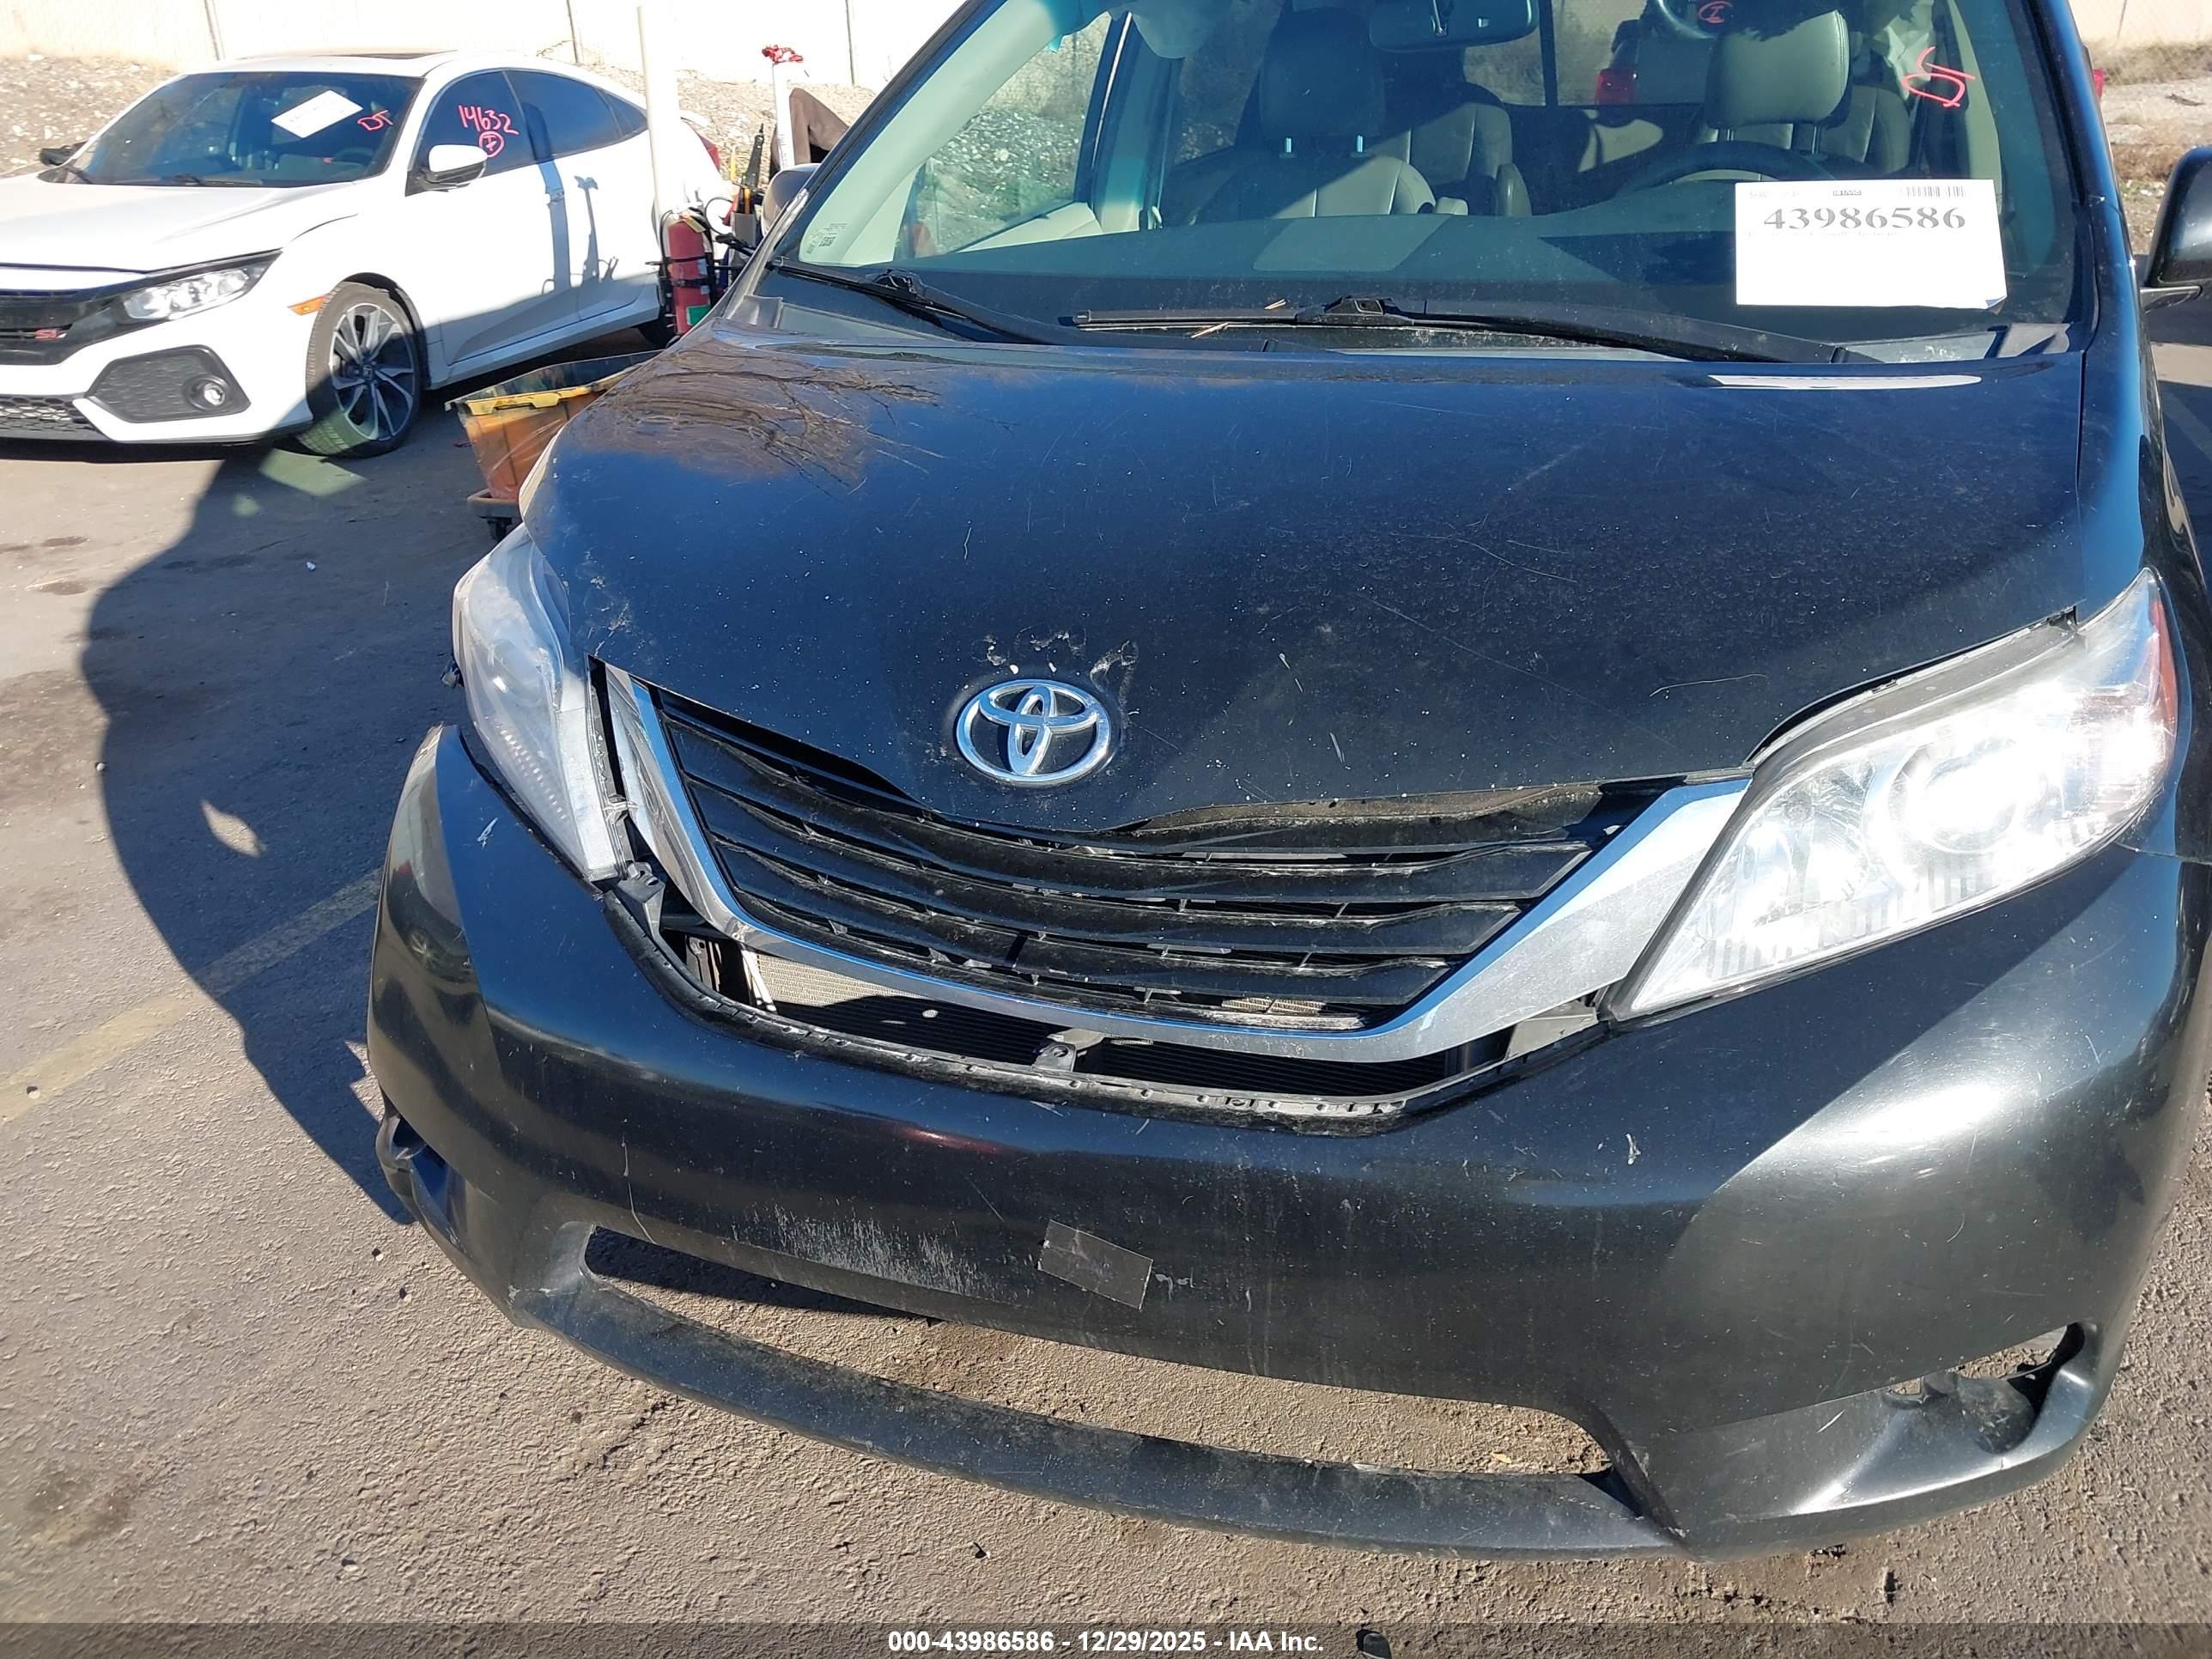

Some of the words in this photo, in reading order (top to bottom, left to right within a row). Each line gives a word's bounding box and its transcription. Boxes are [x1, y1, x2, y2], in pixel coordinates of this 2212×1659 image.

[356, 109, 394, 131] DT
[458, 105, 520, 135] 14632
[1764, 207, 1966, 229] 43986586
